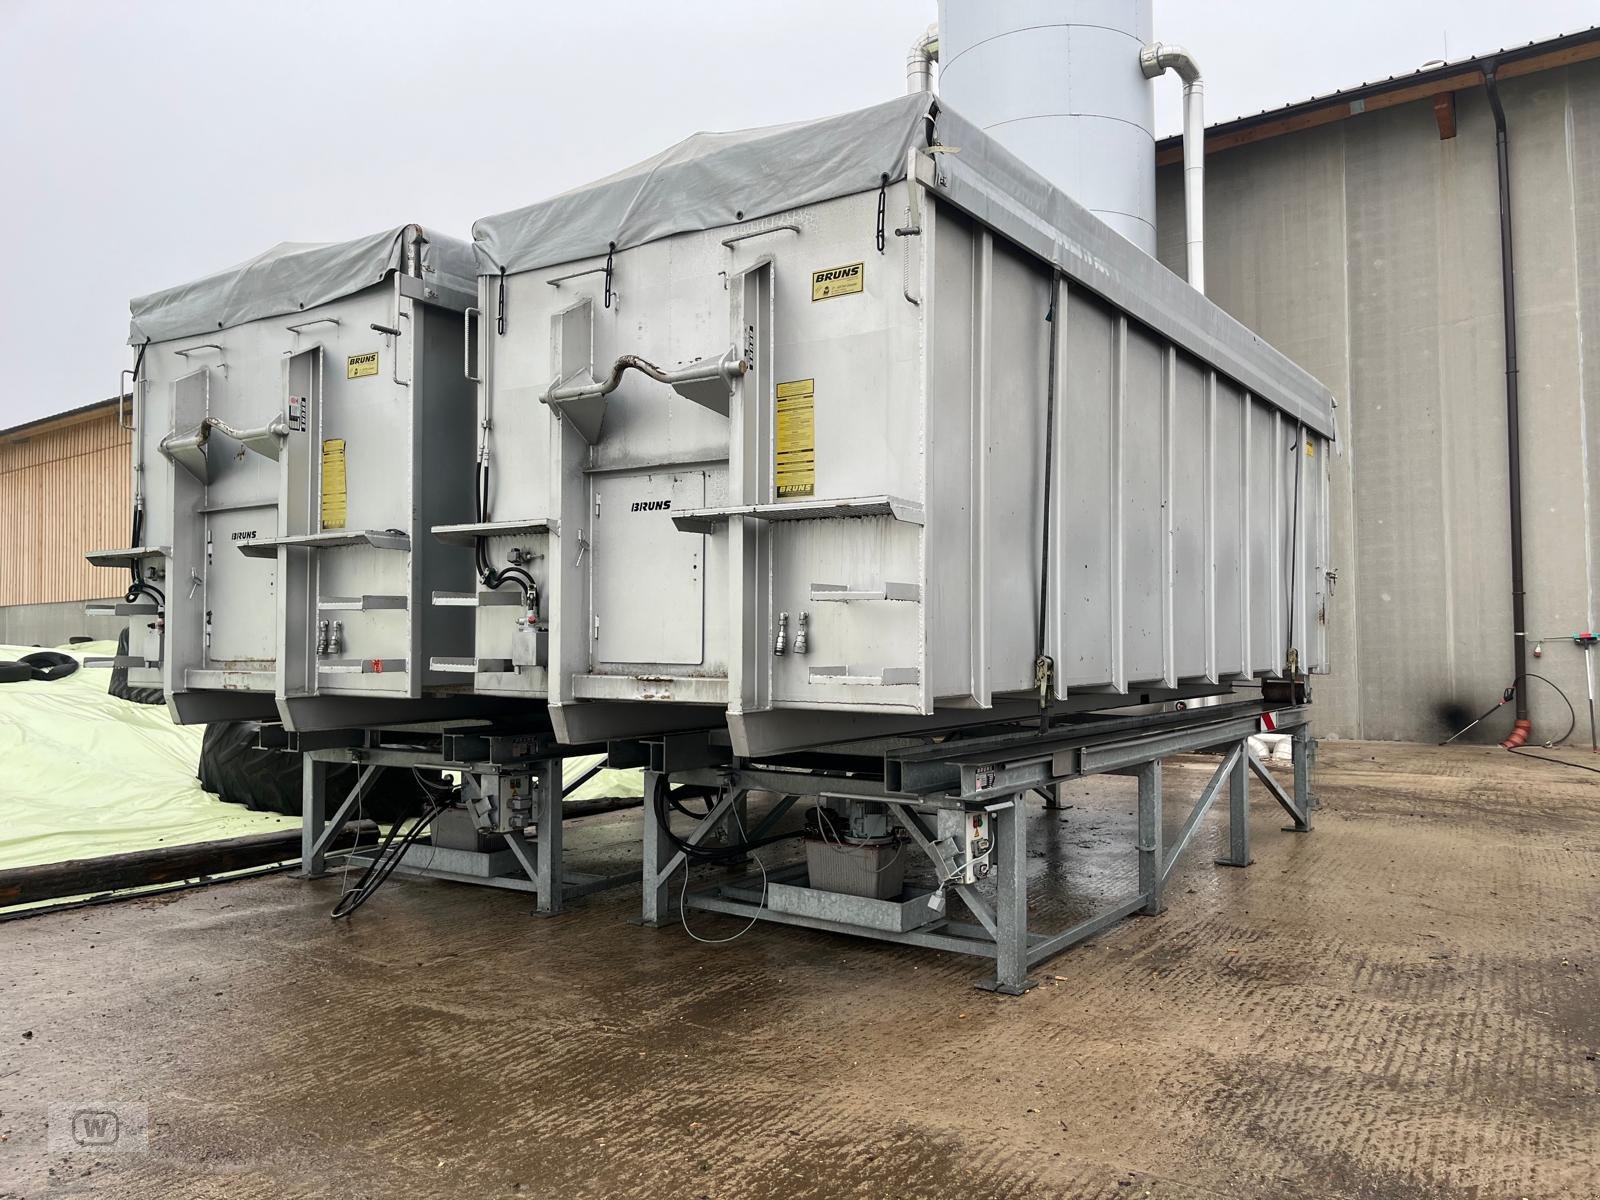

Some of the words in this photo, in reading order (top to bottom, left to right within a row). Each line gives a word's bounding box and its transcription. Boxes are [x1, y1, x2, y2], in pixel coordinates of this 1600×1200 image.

[815, 266, 860, 283] BRUNS
[349, 354, 376, 366] BRUNS
[779, 484, 812, 493] BRUNS
[631, 500, 671, 512] BRUNS
[231, 530, 257, 541] BRUNS
